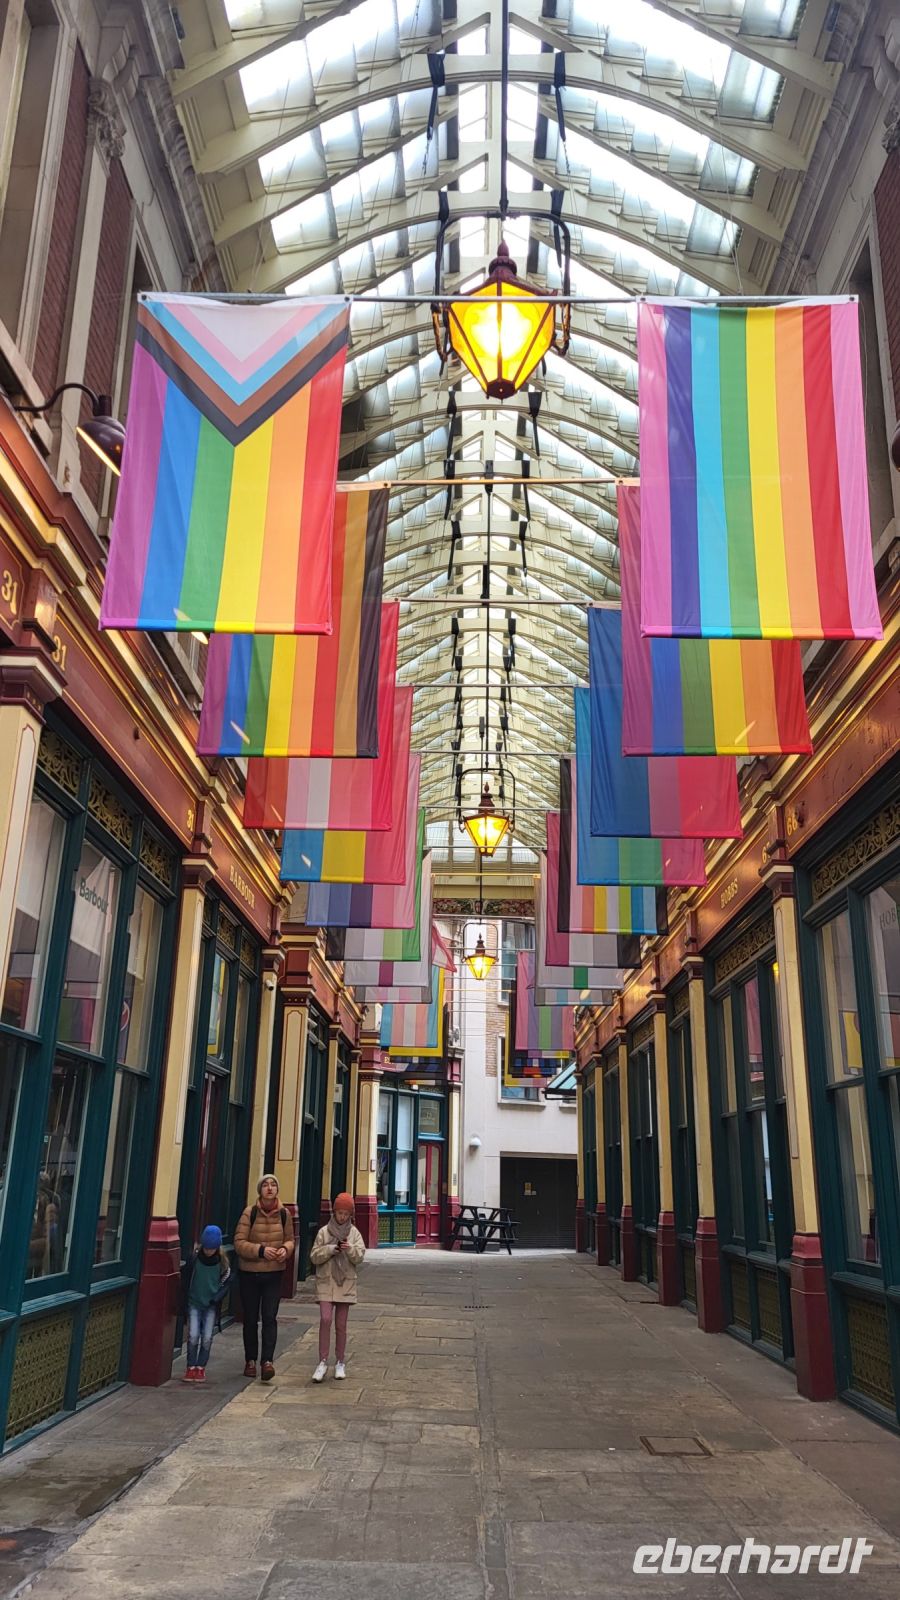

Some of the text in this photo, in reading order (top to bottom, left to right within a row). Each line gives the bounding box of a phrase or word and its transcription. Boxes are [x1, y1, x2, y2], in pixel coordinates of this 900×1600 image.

[2, 570, 18, 615] 31
[52, 635, 67, 672] 31
[230, 864, 255, 909] BARBOUR
